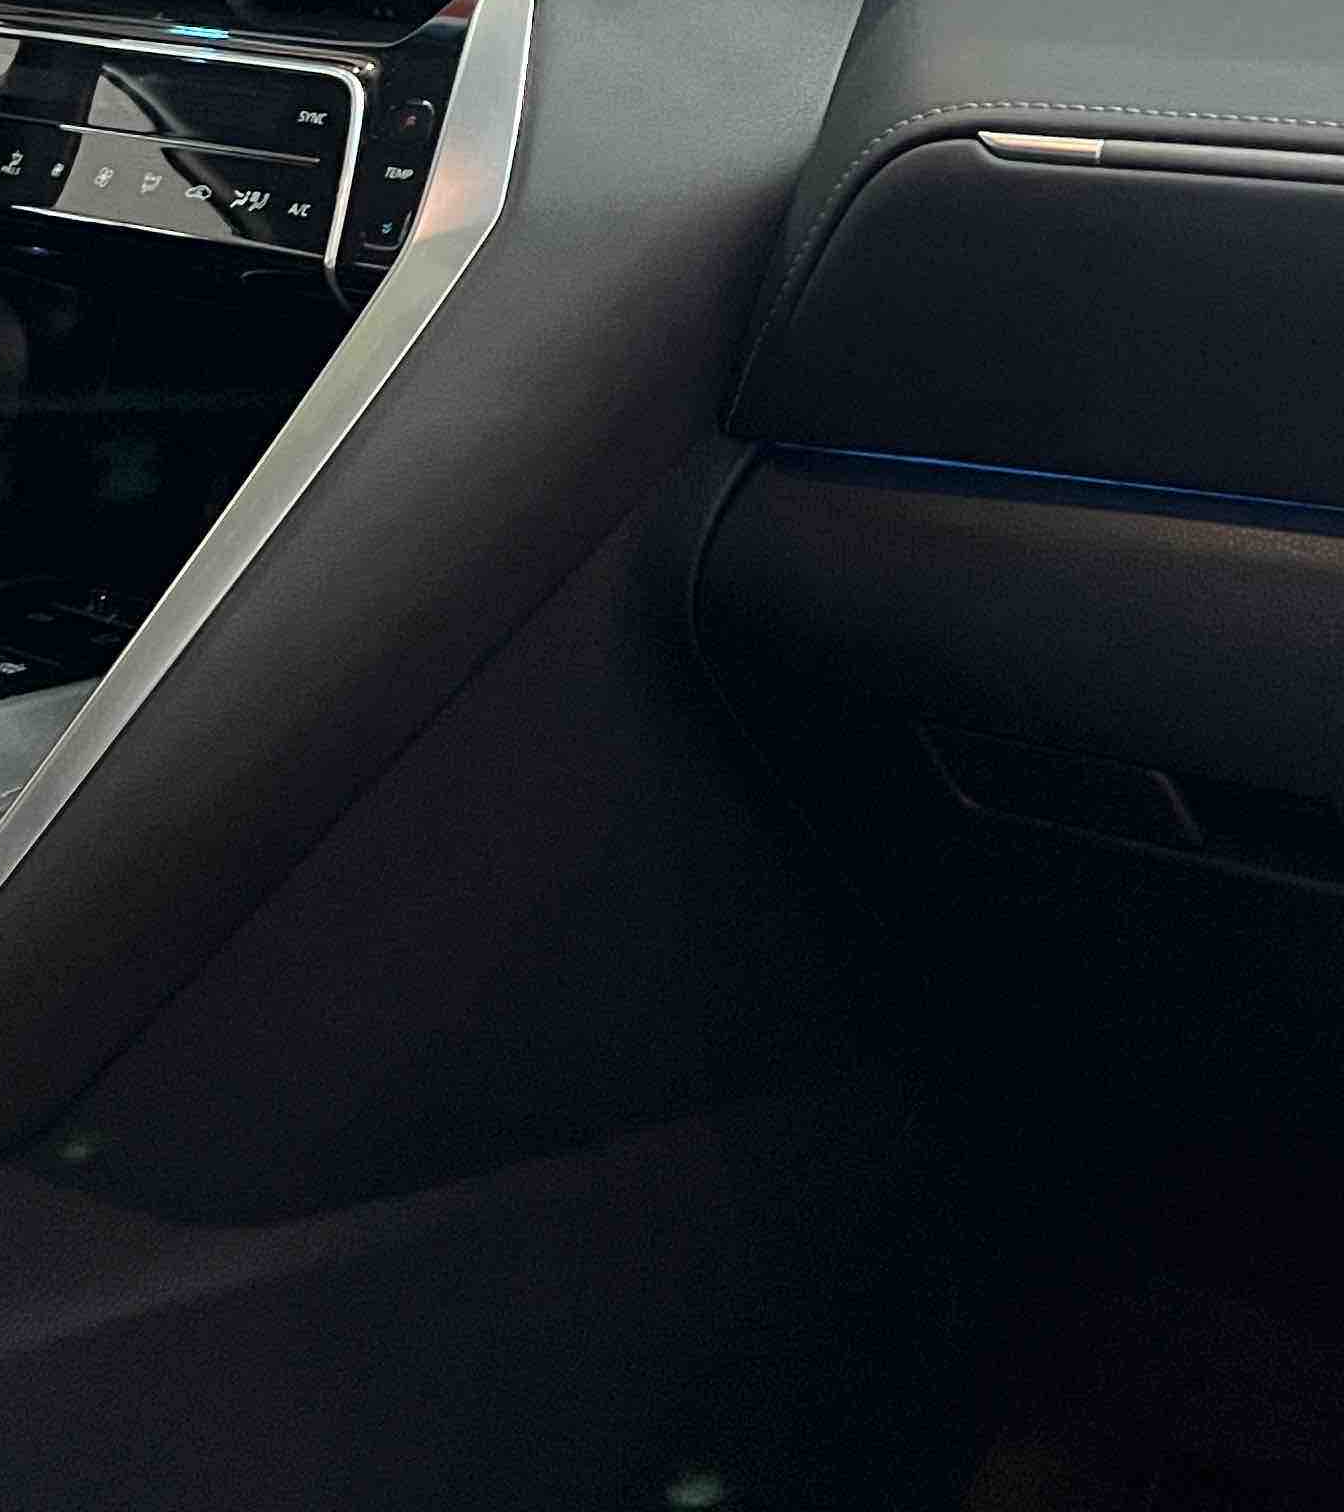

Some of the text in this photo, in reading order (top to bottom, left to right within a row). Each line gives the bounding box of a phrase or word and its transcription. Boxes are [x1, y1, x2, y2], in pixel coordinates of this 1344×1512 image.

[298, 110, 328, 126] SYNC
[384, 166, 414, 180] TEMP
[288, 203, 311, 217] A/C
